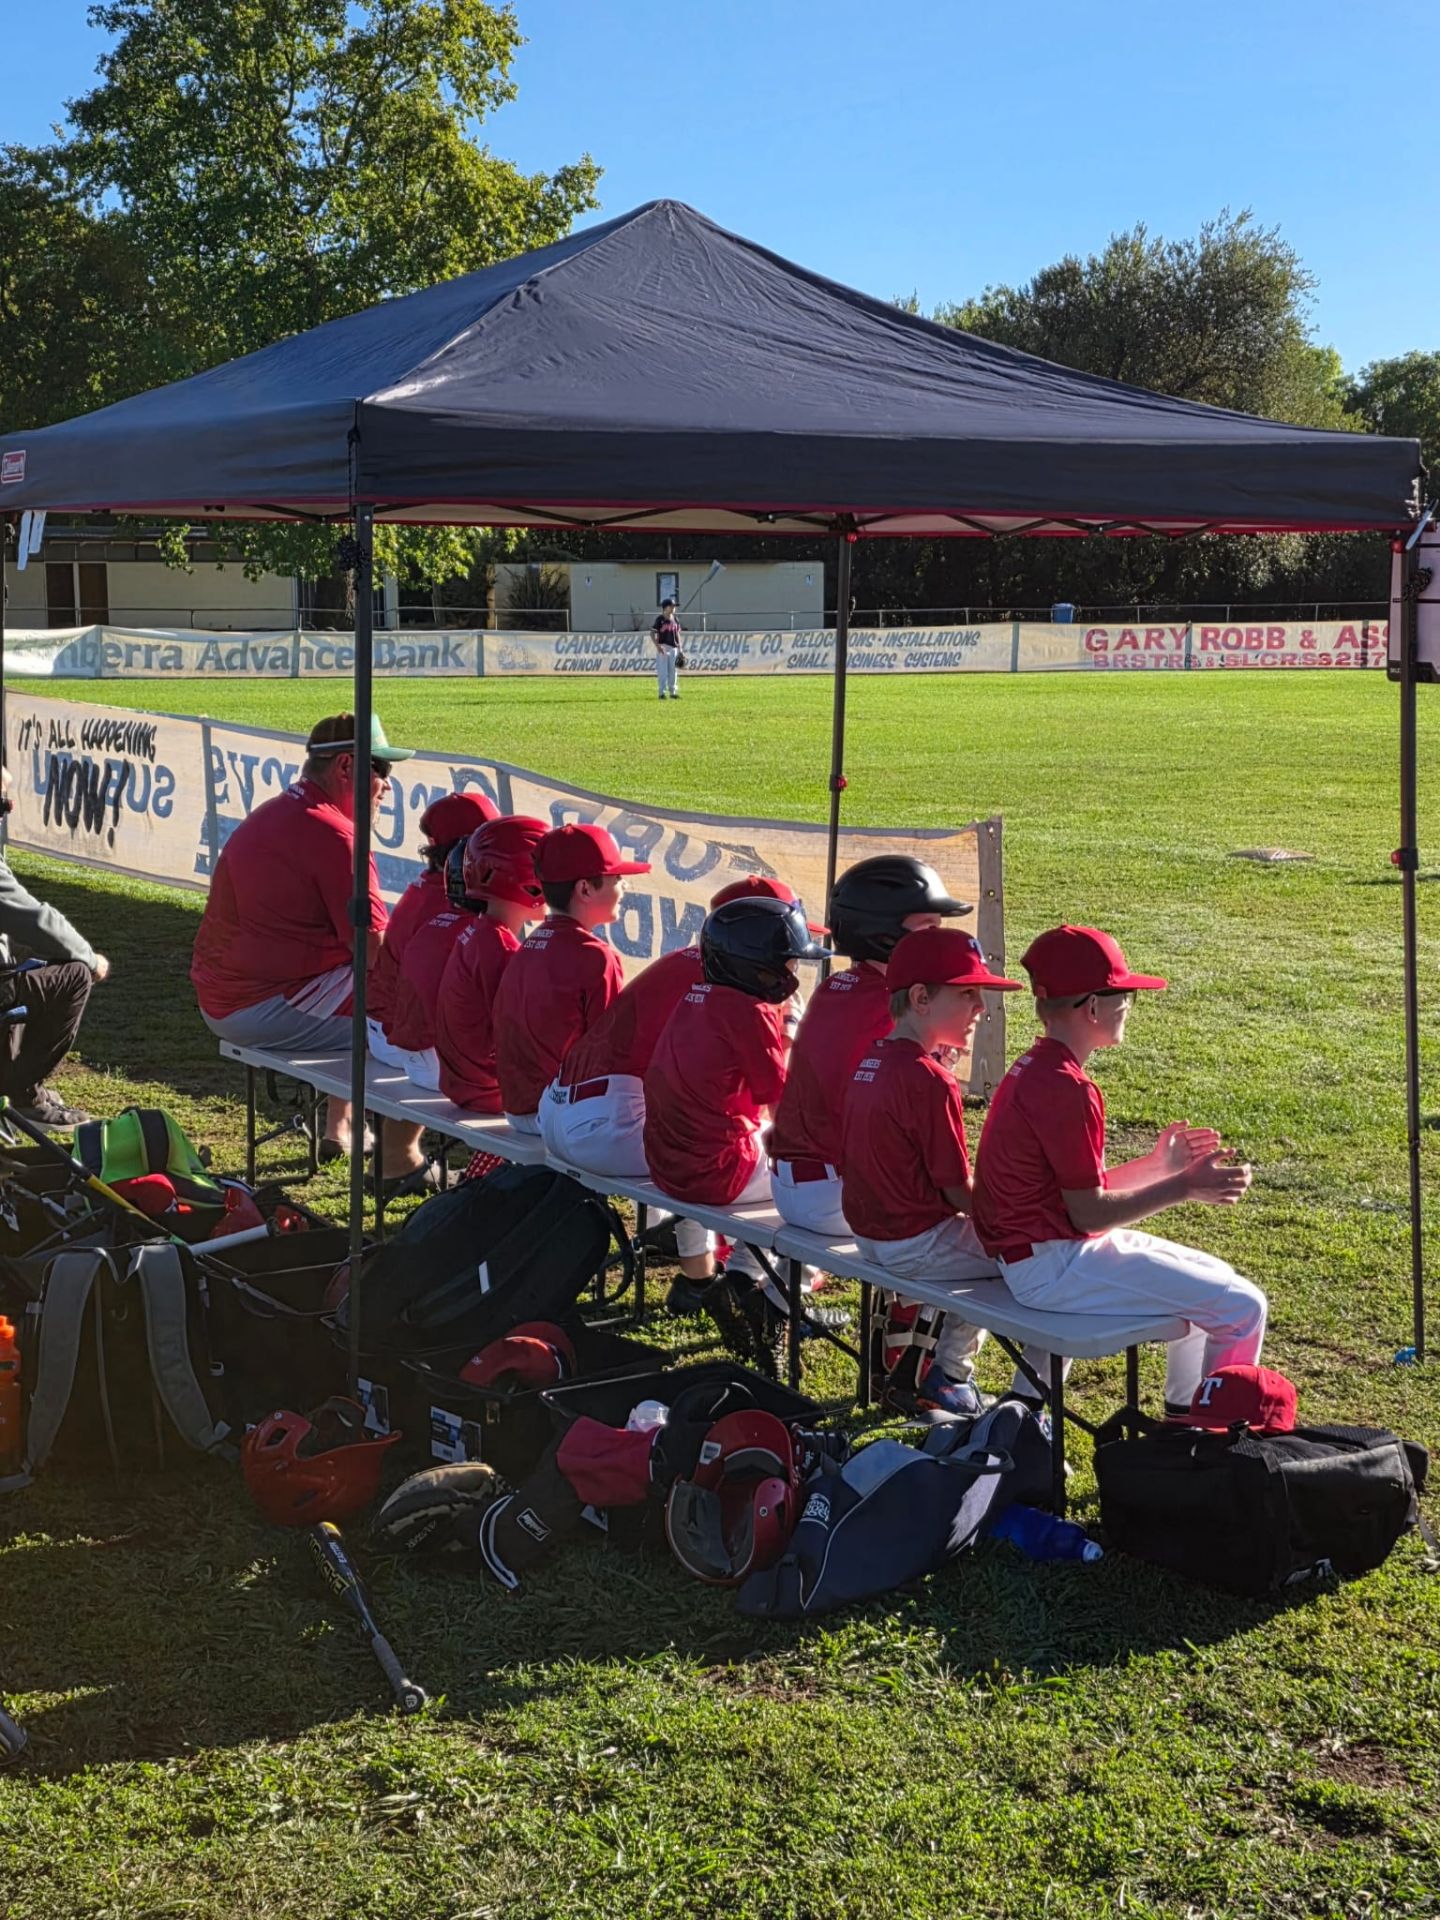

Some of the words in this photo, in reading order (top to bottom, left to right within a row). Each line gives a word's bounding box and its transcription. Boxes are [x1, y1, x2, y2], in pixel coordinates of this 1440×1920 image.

[555, 634, 644, 654] CANBERRA
[682, 634, 752, 654] LEPHONE
[760, 633, 783, 655] CO.
[792, 632, 875, 648] RELOCONS
[883, 631, 980, 647] INSTALLATIONS
[1085, 628, 1190, 652] GARY
[1200, 626, 1285, 651] ROBB
[1299, 630, 1317, 649] &
[57, 635, 183, 670] nberra
[195, 638, 355, 671] Advance
[373, 636, 465, 669] Bank
[553, 658, 602, 671] LENNON
[609, 658, 656, 671] DAPOZZ
[787, 652, 828, 668] SMALL
[846, 652, 897, 668] SINESS
[904, 651, 961, 668] SYSTEMS
[18, 713, 42, 751] IT'S
[48, 718, 75, 749] ALL
[81, 718, 157, 763] HAPPENING
[43, 747, 129, 848] NOW!
[1199, 1377, 1222, 1407] T
